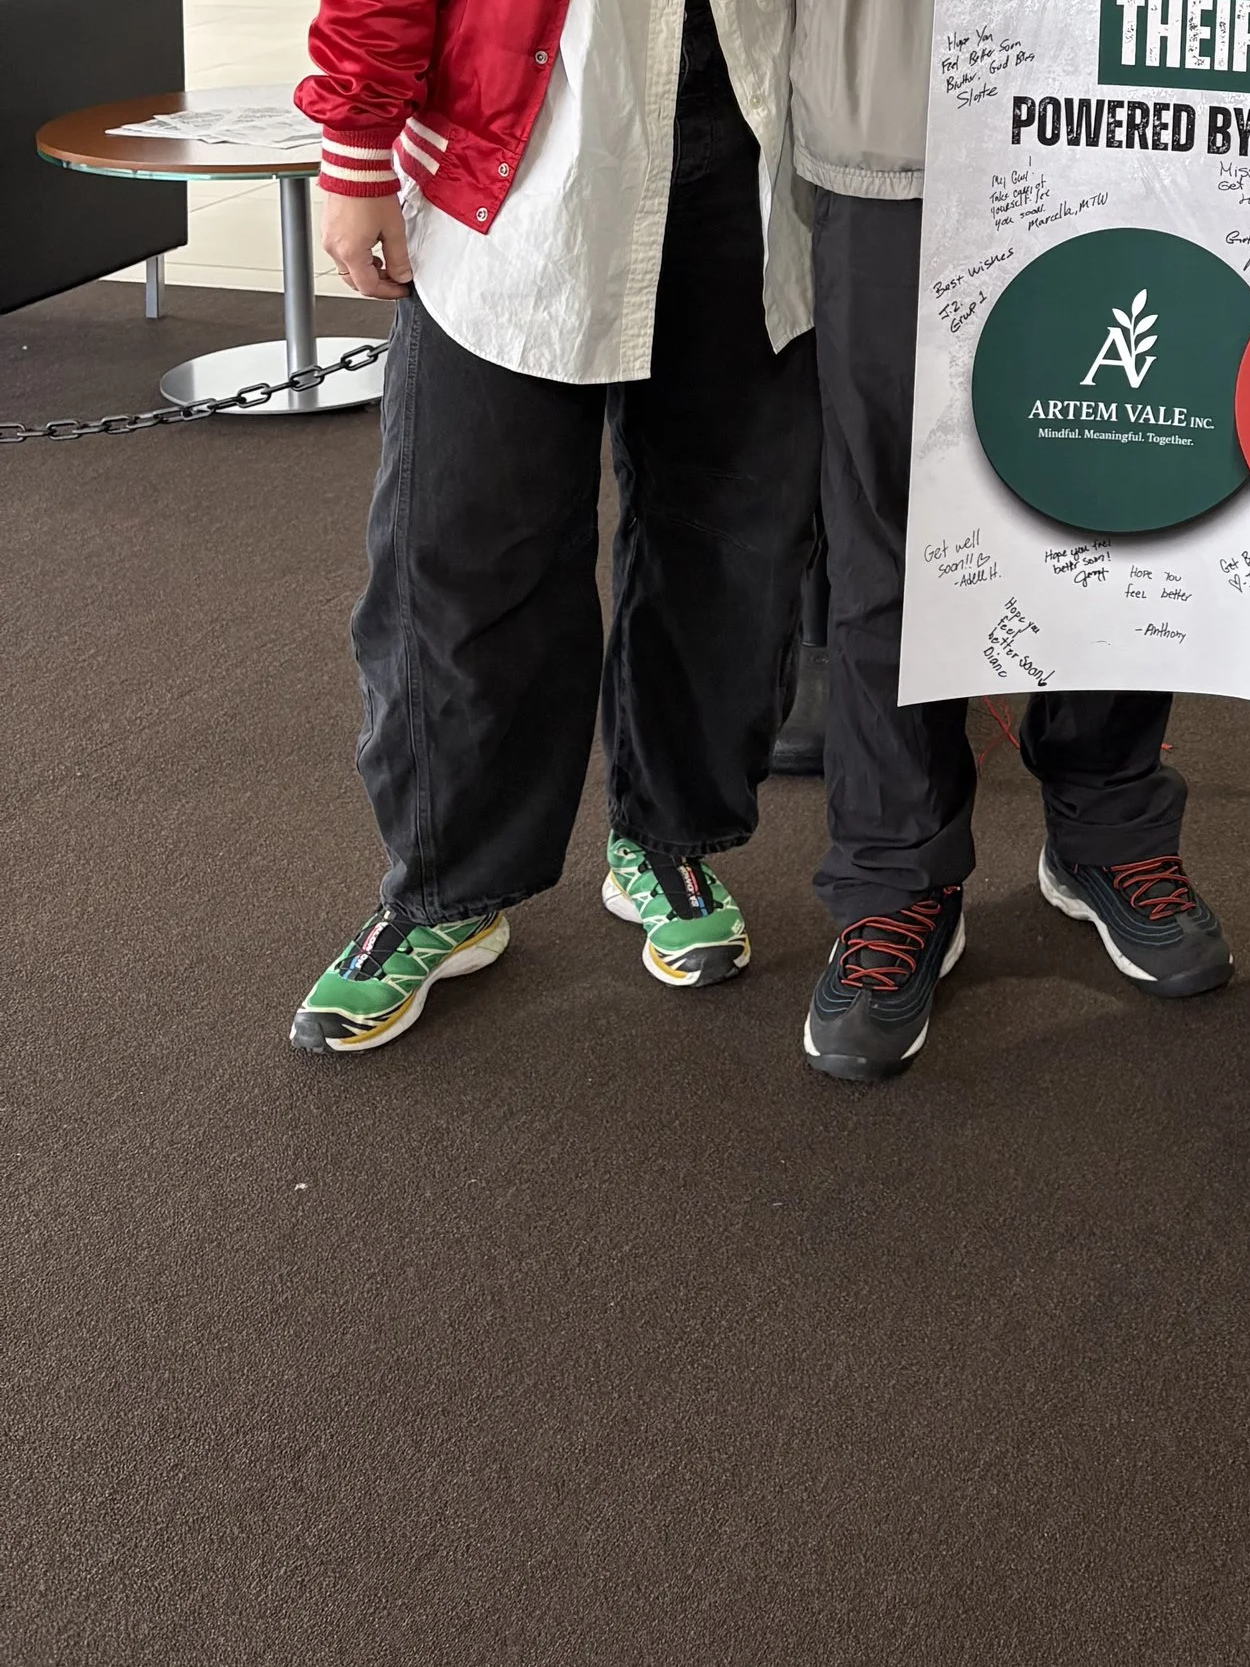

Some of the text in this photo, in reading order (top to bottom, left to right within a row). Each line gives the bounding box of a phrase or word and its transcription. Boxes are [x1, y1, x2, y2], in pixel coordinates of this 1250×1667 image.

[1011, 95, 1196, 153] POWERED
[1218, 180, 1244, 190] Get
[995, 217, 1014, 231] you
[933, 276, 964, 299] Best
[979, 291, 987, 303] 1
[1029, 400, 1215, 429] ARTEM VALE INC.
[1038, 428, 1194, 446] Mindful. Meaningful. Together.
[924, 529, 980, 562] Get well
[1045, 550, 1068, 563] Hope
[1070, 545, 1089, 561] you
[1220, 558, 1239, 574] Get
[1161, 588, 1192, 602] better
[1004, 597, 1026, 623] Hope
